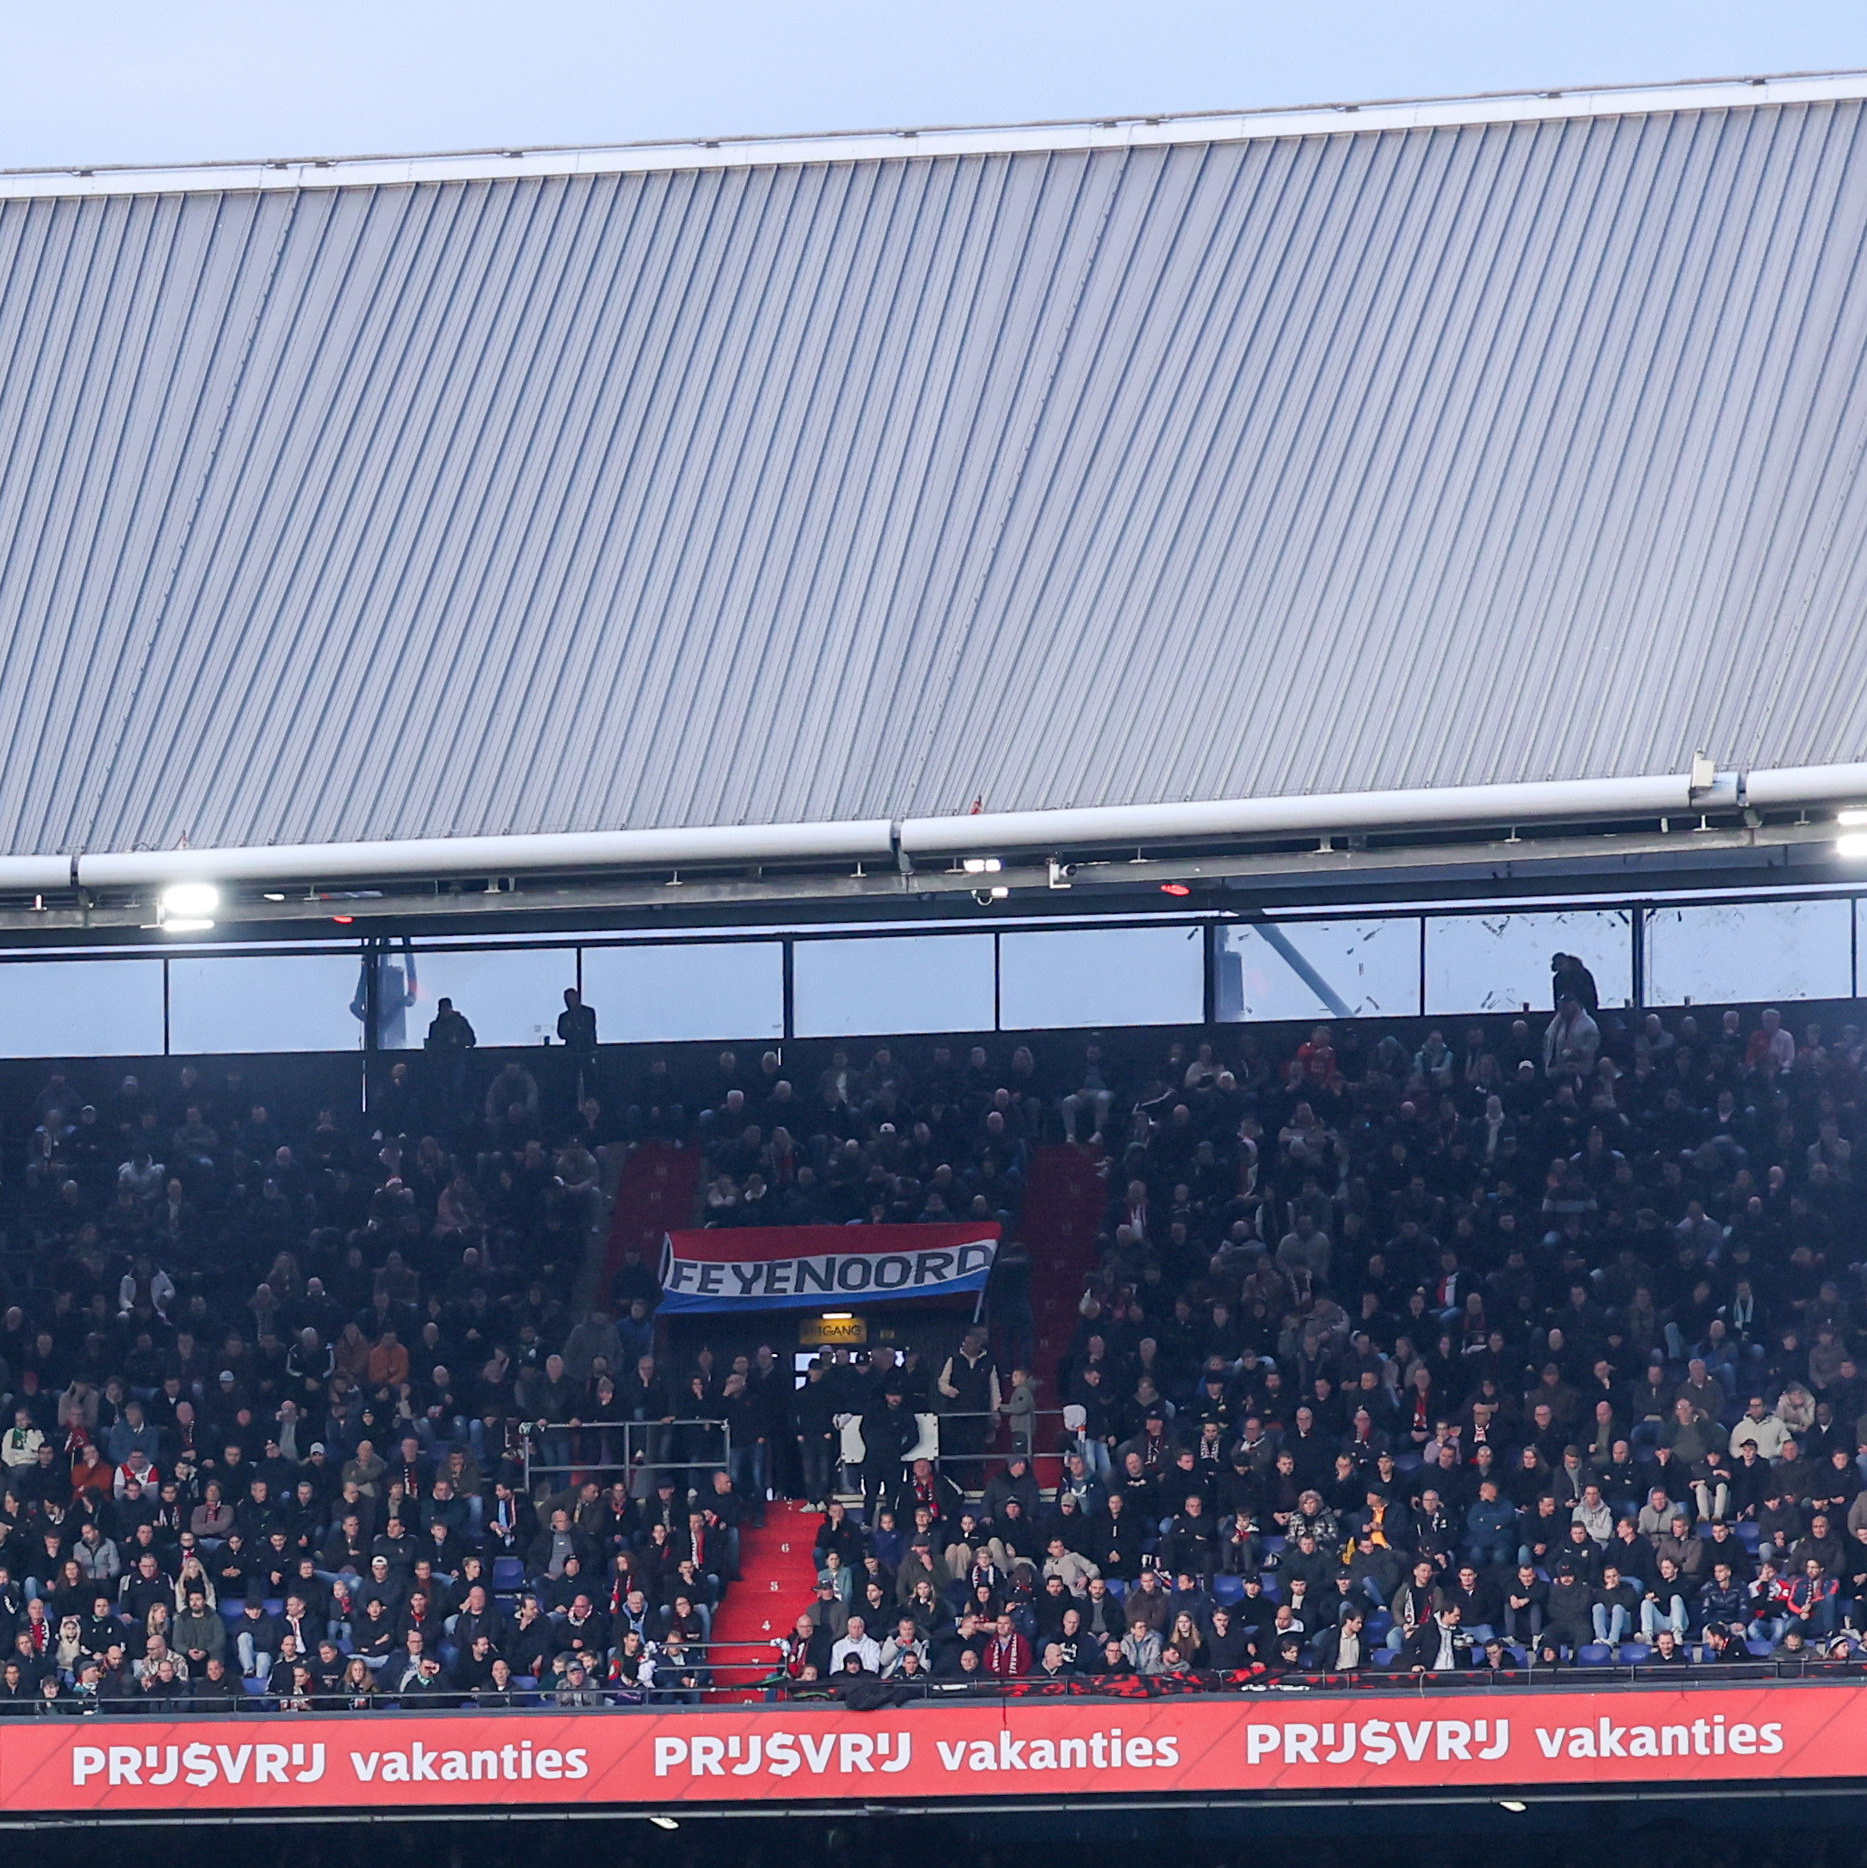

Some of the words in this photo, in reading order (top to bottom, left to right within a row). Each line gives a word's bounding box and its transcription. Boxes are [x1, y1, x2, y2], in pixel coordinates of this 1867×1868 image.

[670, 1244, 996, 1295] FEYENOORD
[781, 1543, 790, 1553] 6
[770, 1581, 779, 1592] 5
[761, 1620, 771, 1631] 4
[936, 1728, 1180, 1772] vakanties
[1535, 1714, 1784, 1758] vakanties
[349, 1739, 590, 1782] vakanties
